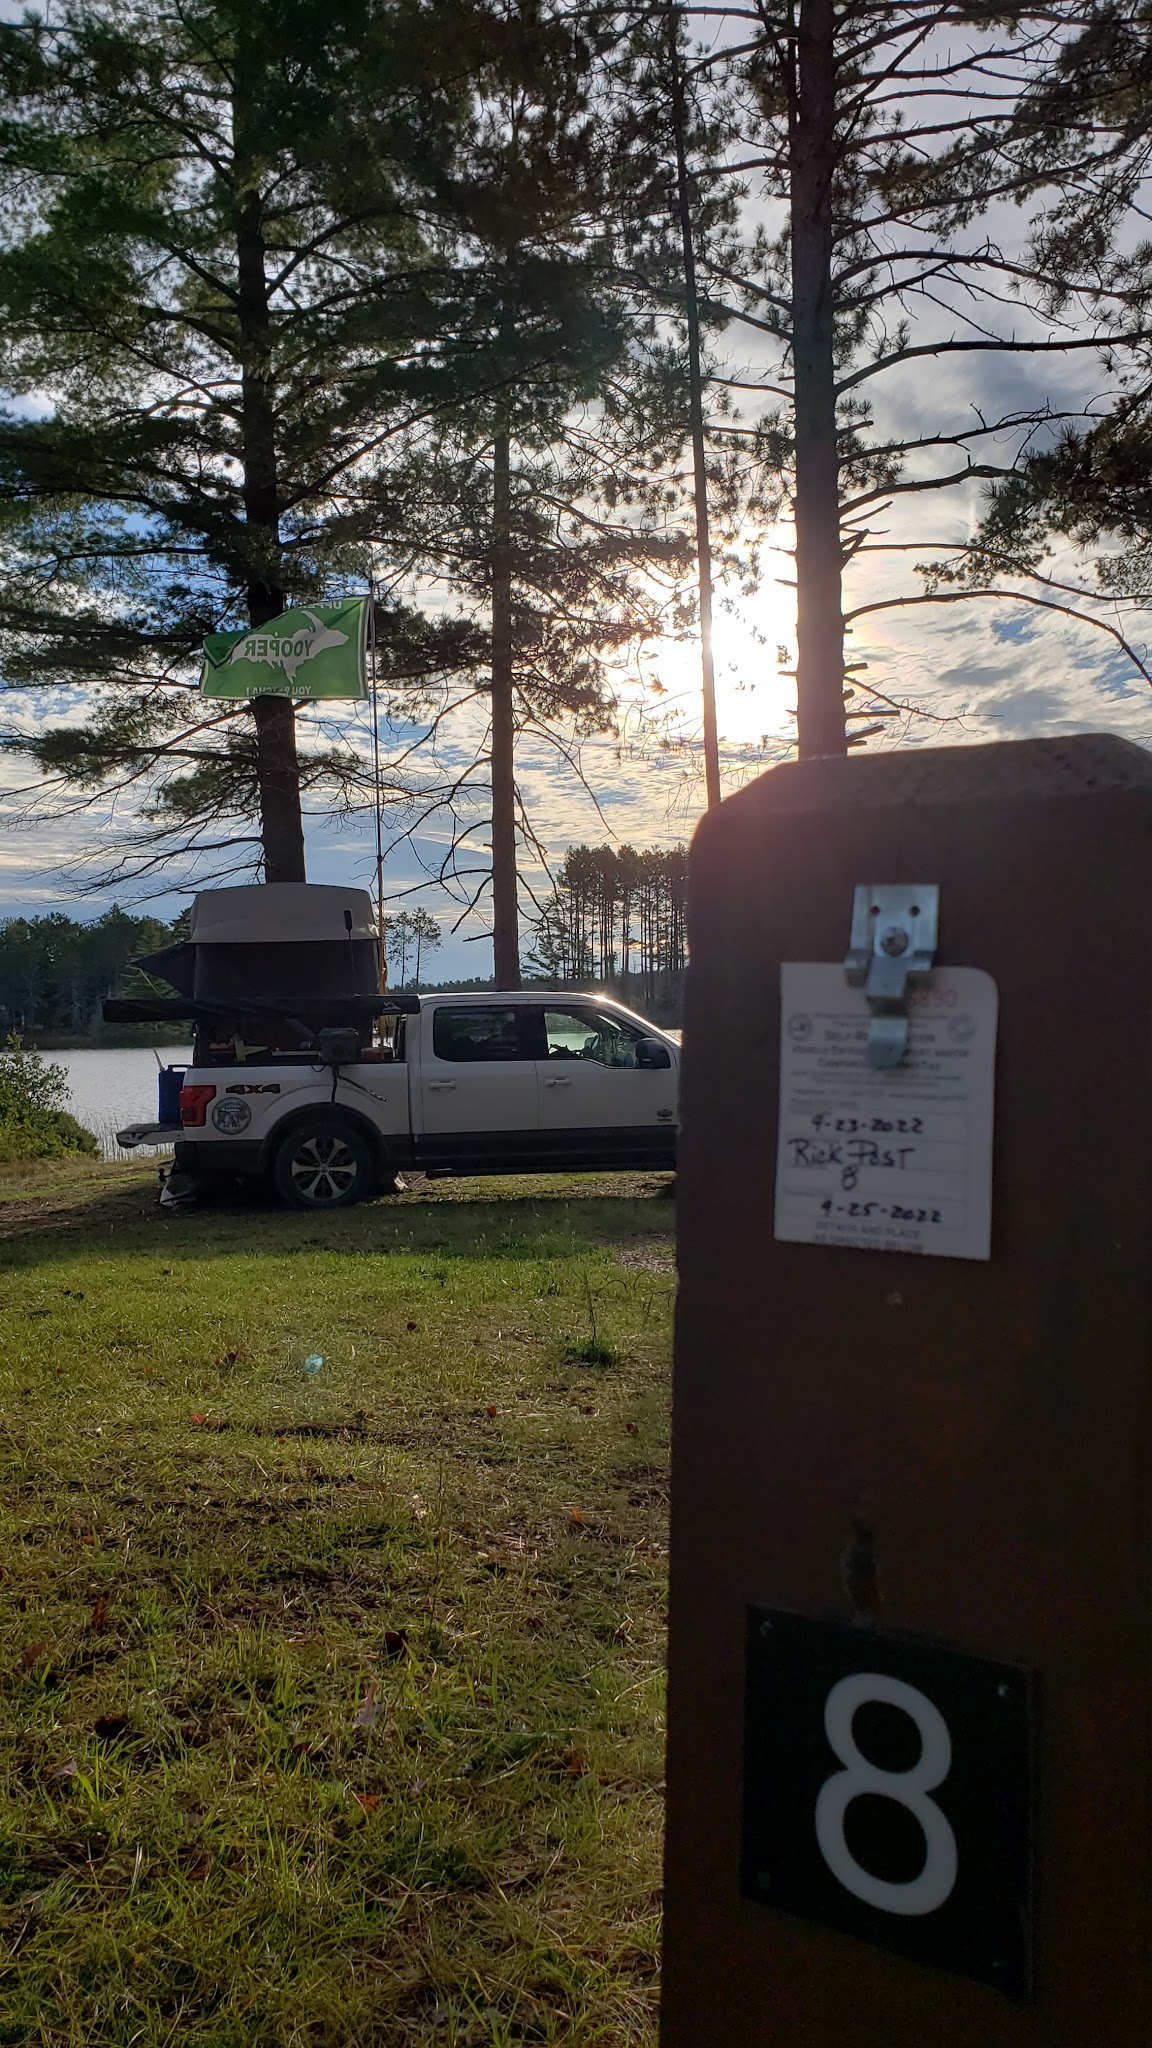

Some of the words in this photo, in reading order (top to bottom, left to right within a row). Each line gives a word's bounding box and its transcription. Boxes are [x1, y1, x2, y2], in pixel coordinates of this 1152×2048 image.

[811, 1114, 924, 1134] 9-23-2022
[841, 1165, 859, 1191] 8
[821, 1199, 942, 1224] 9-25-2022
[813, 1671, 960, 1918] 8
